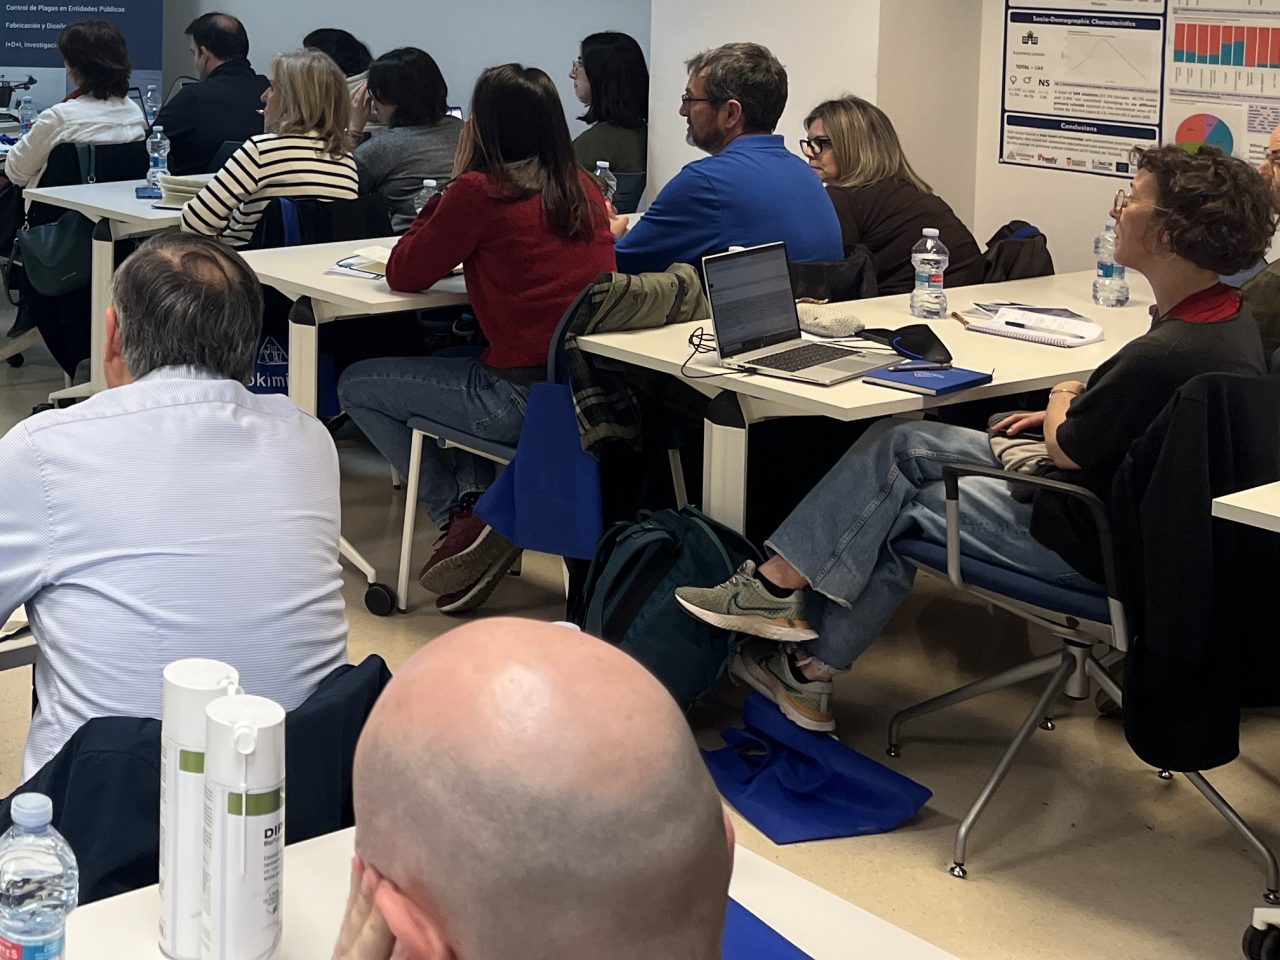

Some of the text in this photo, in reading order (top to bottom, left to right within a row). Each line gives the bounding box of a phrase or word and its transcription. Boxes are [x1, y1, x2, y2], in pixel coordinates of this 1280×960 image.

[6, 4, 29, 12] Control
[38, 5, 59, 14] Plagas
[1091, 18, 1137, 28] Characteristics
[24, 41, 58, 50] Investigaci
[1038, 79, 1051, 87] NS
[1060, 122, 1098, 133] Conclusions
